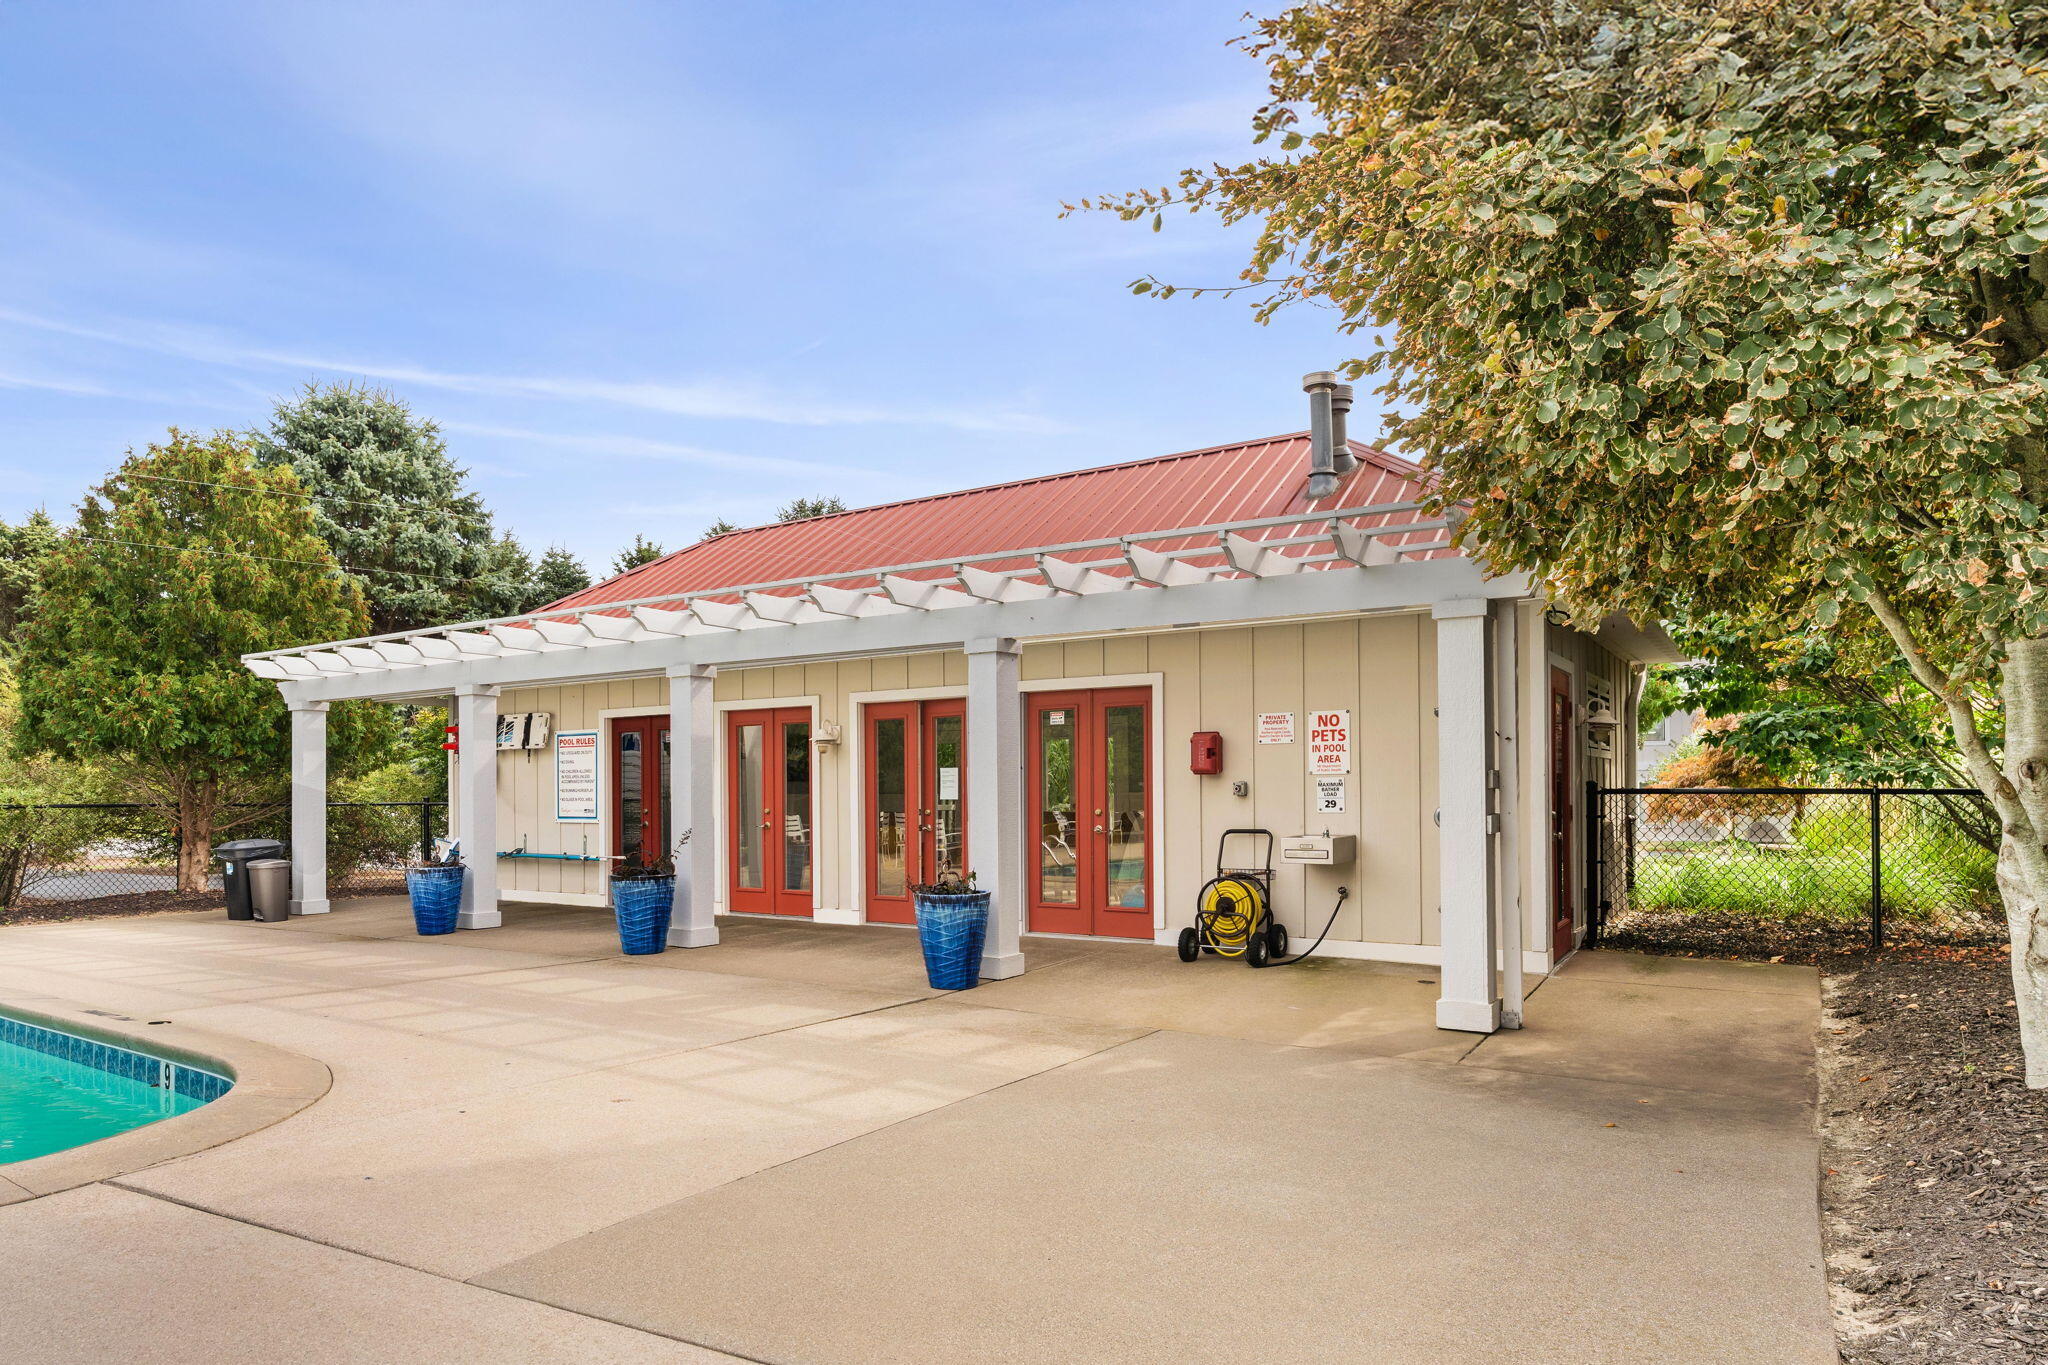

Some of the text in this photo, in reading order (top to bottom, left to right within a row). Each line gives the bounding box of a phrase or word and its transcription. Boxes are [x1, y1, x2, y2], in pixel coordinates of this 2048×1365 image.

[1317, 714, 1340, 727] NO
[1311, 728, 1347, 742] PETS
[559, 737, 595, 746] POOL RULES
[1311, 744, 1347, 753] IN POOL
[1317, 754, 1341, 763] AREA
[1324, 799, 1337, 809] 29
[164, 1063, 170, 1090] 9
